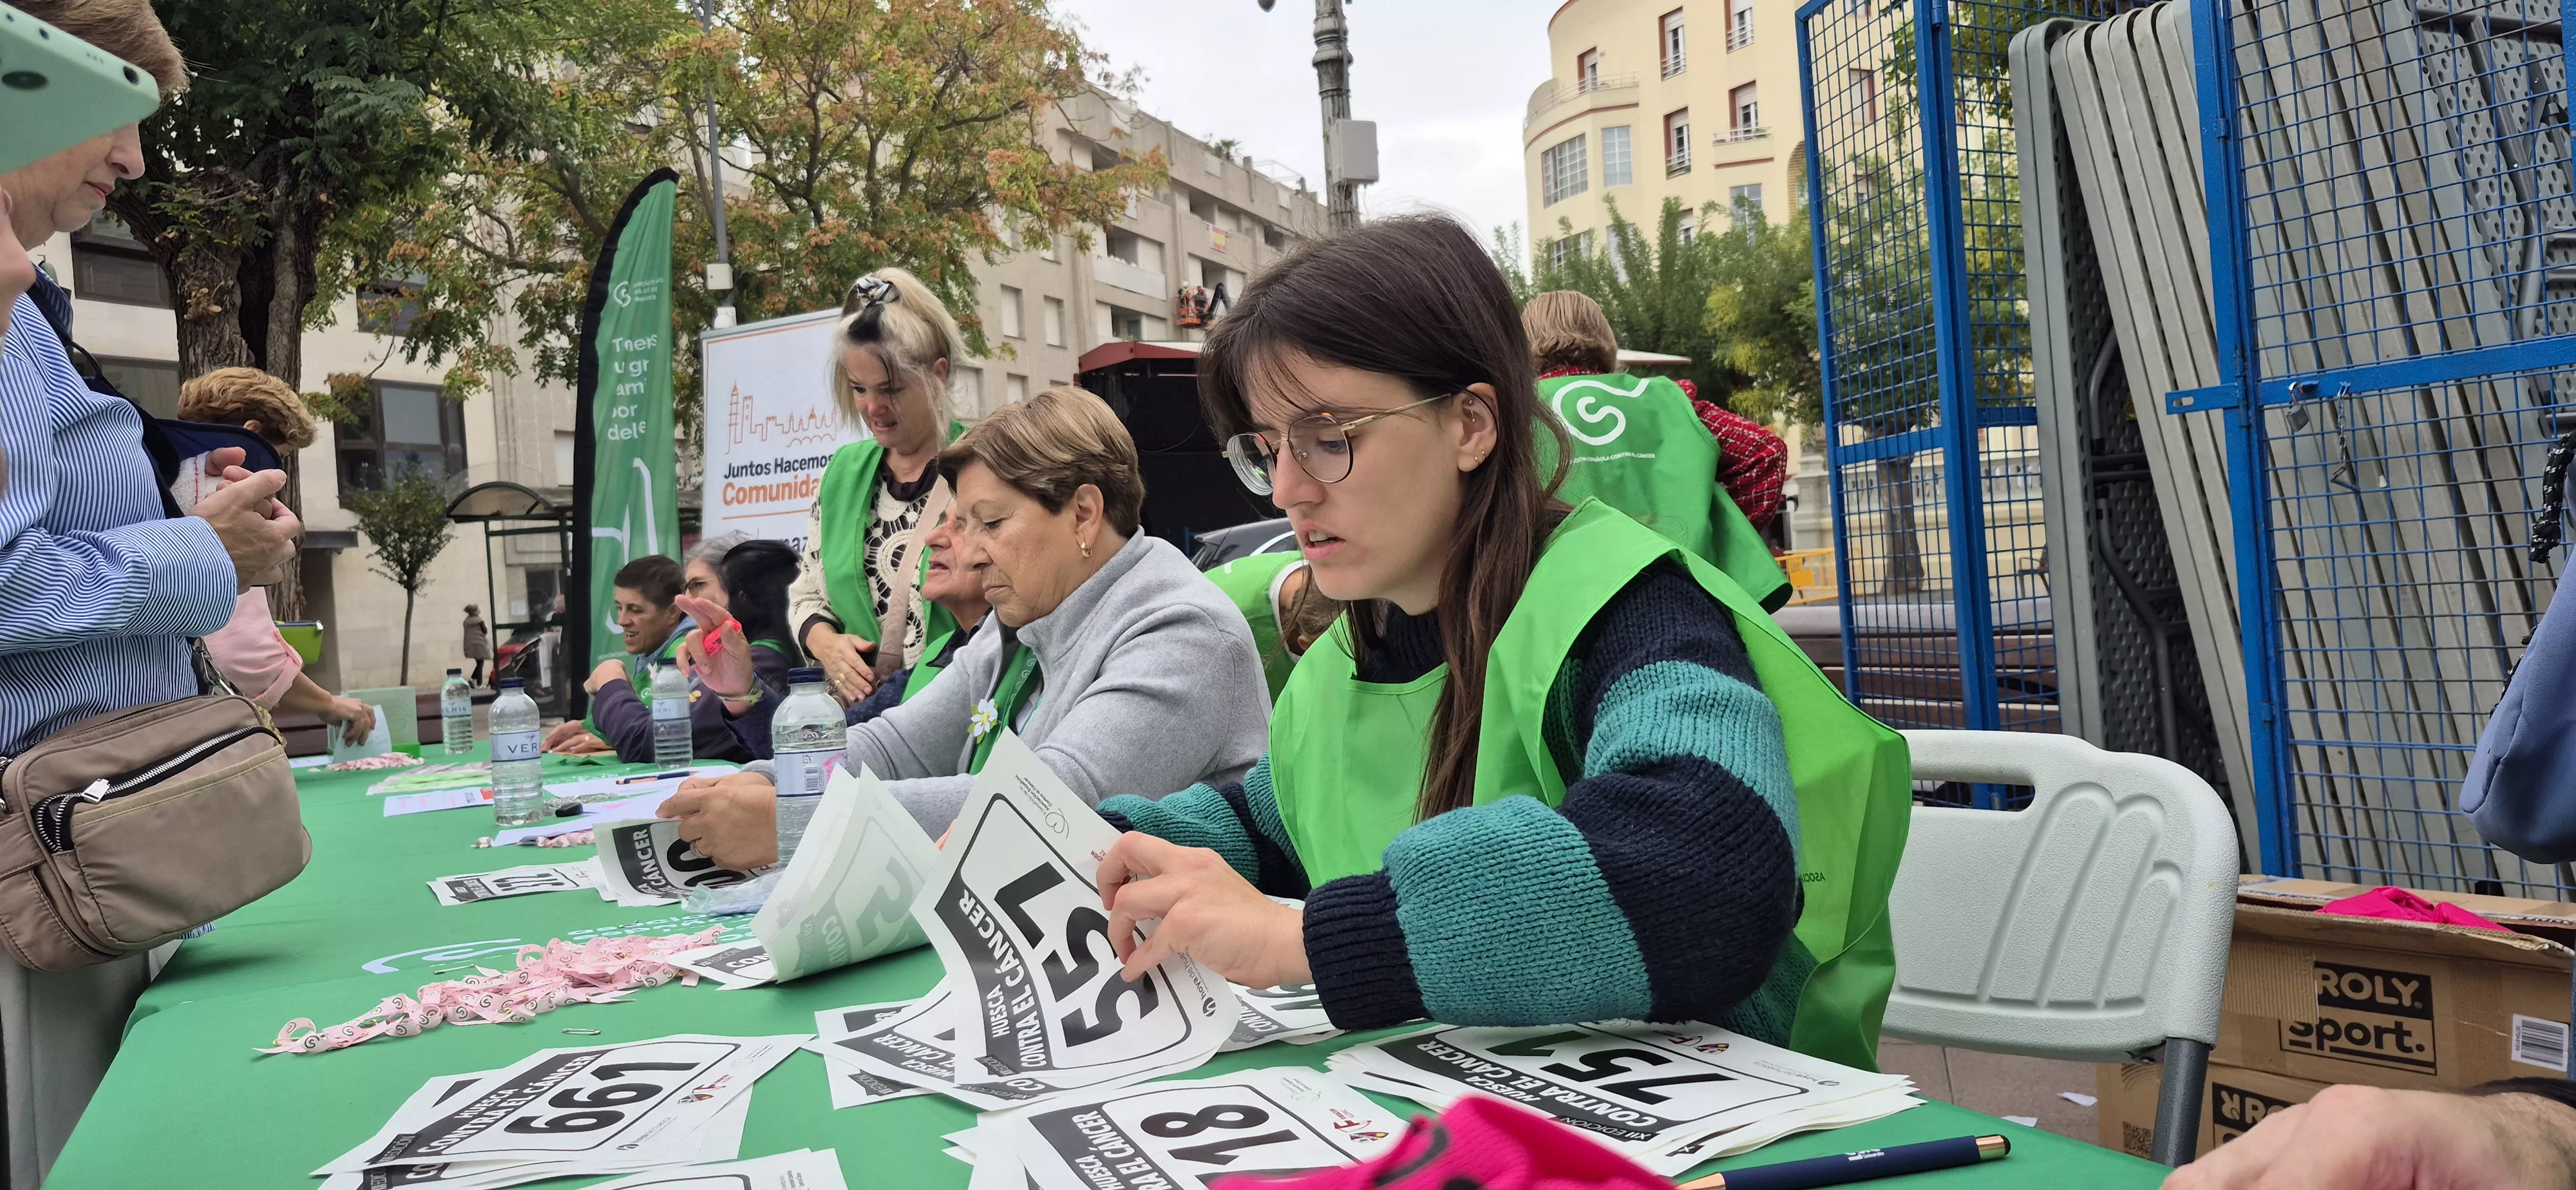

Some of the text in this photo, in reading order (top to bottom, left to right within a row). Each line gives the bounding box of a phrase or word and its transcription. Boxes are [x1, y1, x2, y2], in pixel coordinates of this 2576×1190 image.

[723, 473, 821, 505] Comunida
[724, 461, 772, 479] Juntos
[633, 828, 668, 888] CÁNCER
[959, 888, 1025, 987] CÁNCER
[994, 861, 1159, 1048] 557
[987, 984, 1010, 1038] HUESCA
[1011, 983, 1037, 1015] EL
[873, 1033, 947, 1061] CÁNCER
[1016, 1009, 1047, 1068] CONTRA
[1417, 1041, 1658, 1128] CONTRA EL CÁNCER
[1466, 1075, 1543, 1102] HUESCA
[1486, 1030, 1740, 1105] 751
[417, 1053, 601, 1154] CONTRA EL CÁNCER
[453, 1088, 520, 1119] HUESCA
[504, 1061, 701, 1134] 661
[1072, 1110, 1137, 1158] CÁNCER
[1560, 1116, 1653, 1140] XII EDICIÓN
[1115, 1157, 1153, 1179] EL
